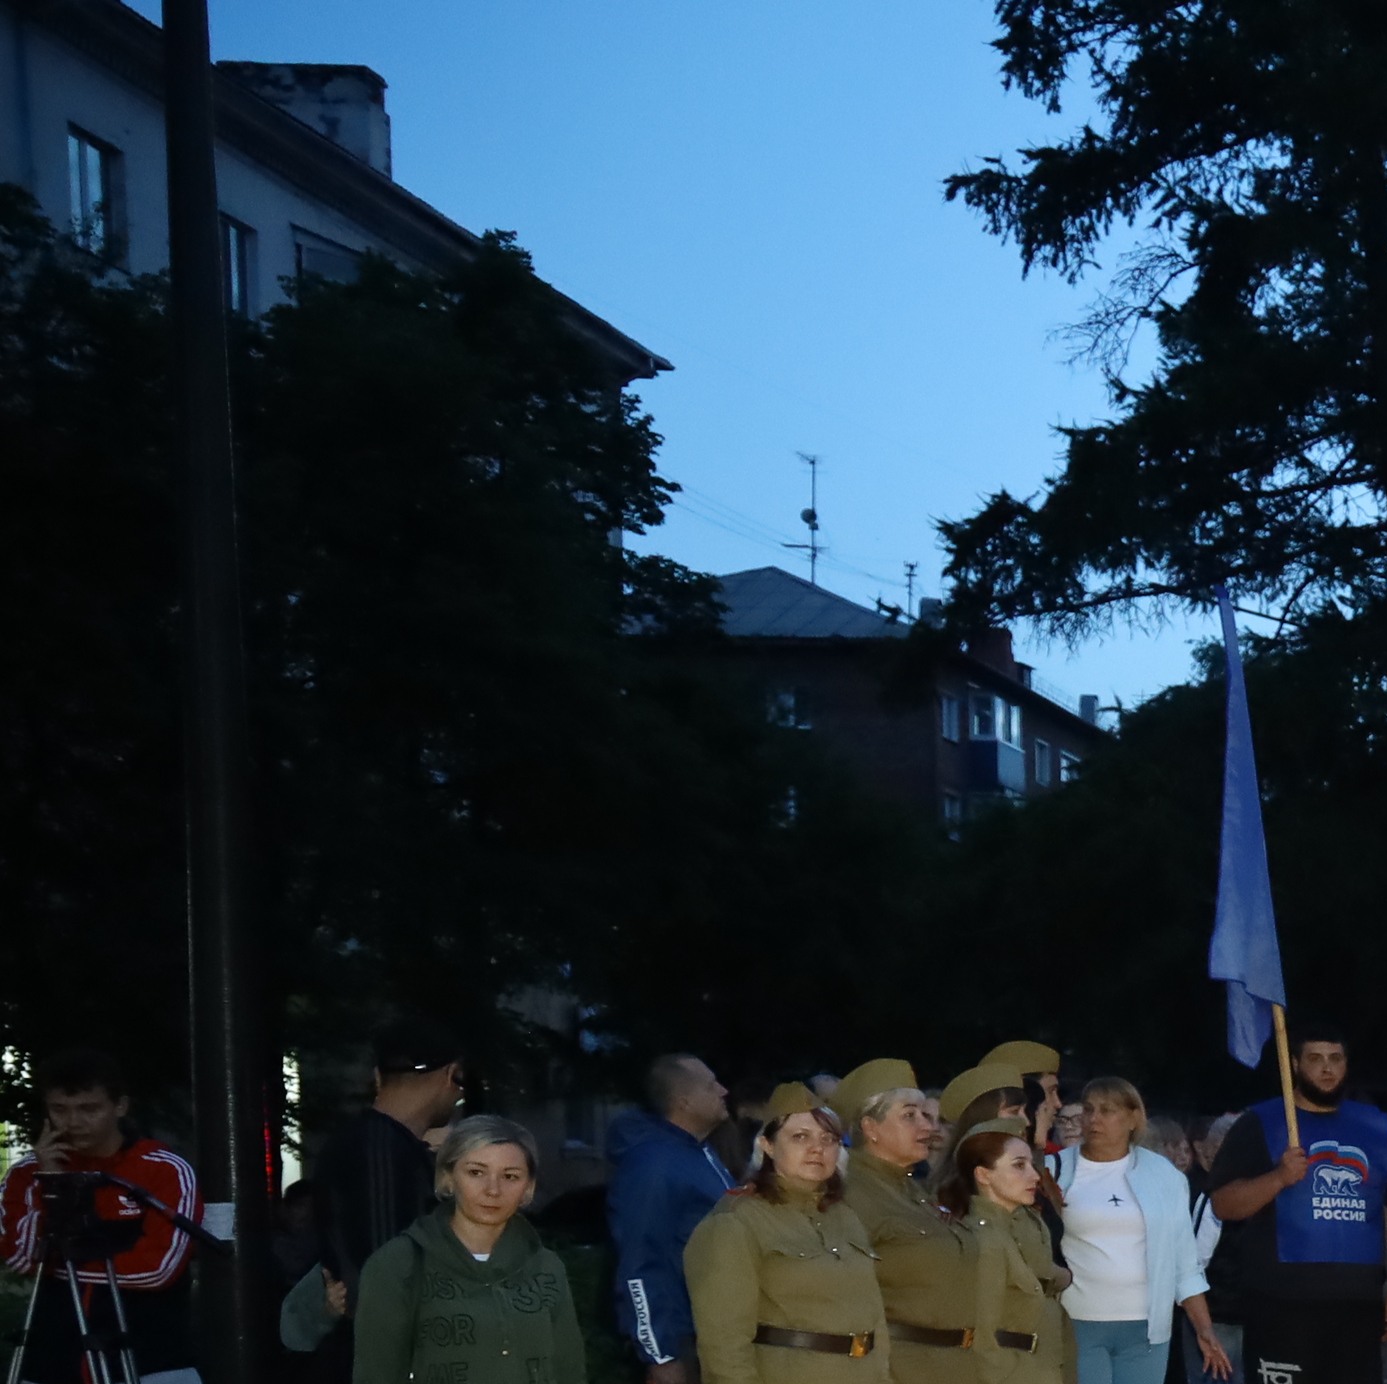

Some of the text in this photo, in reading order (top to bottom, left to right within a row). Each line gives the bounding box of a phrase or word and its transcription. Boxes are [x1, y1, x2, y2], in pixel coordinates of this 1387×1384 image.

[1312, 1197, 1366, 1209] ЕДИНАЯ
[1313, 1209, 1366, 1222] РОССИЯ
[630, 1282, 647, 1326] РОССИЯ
